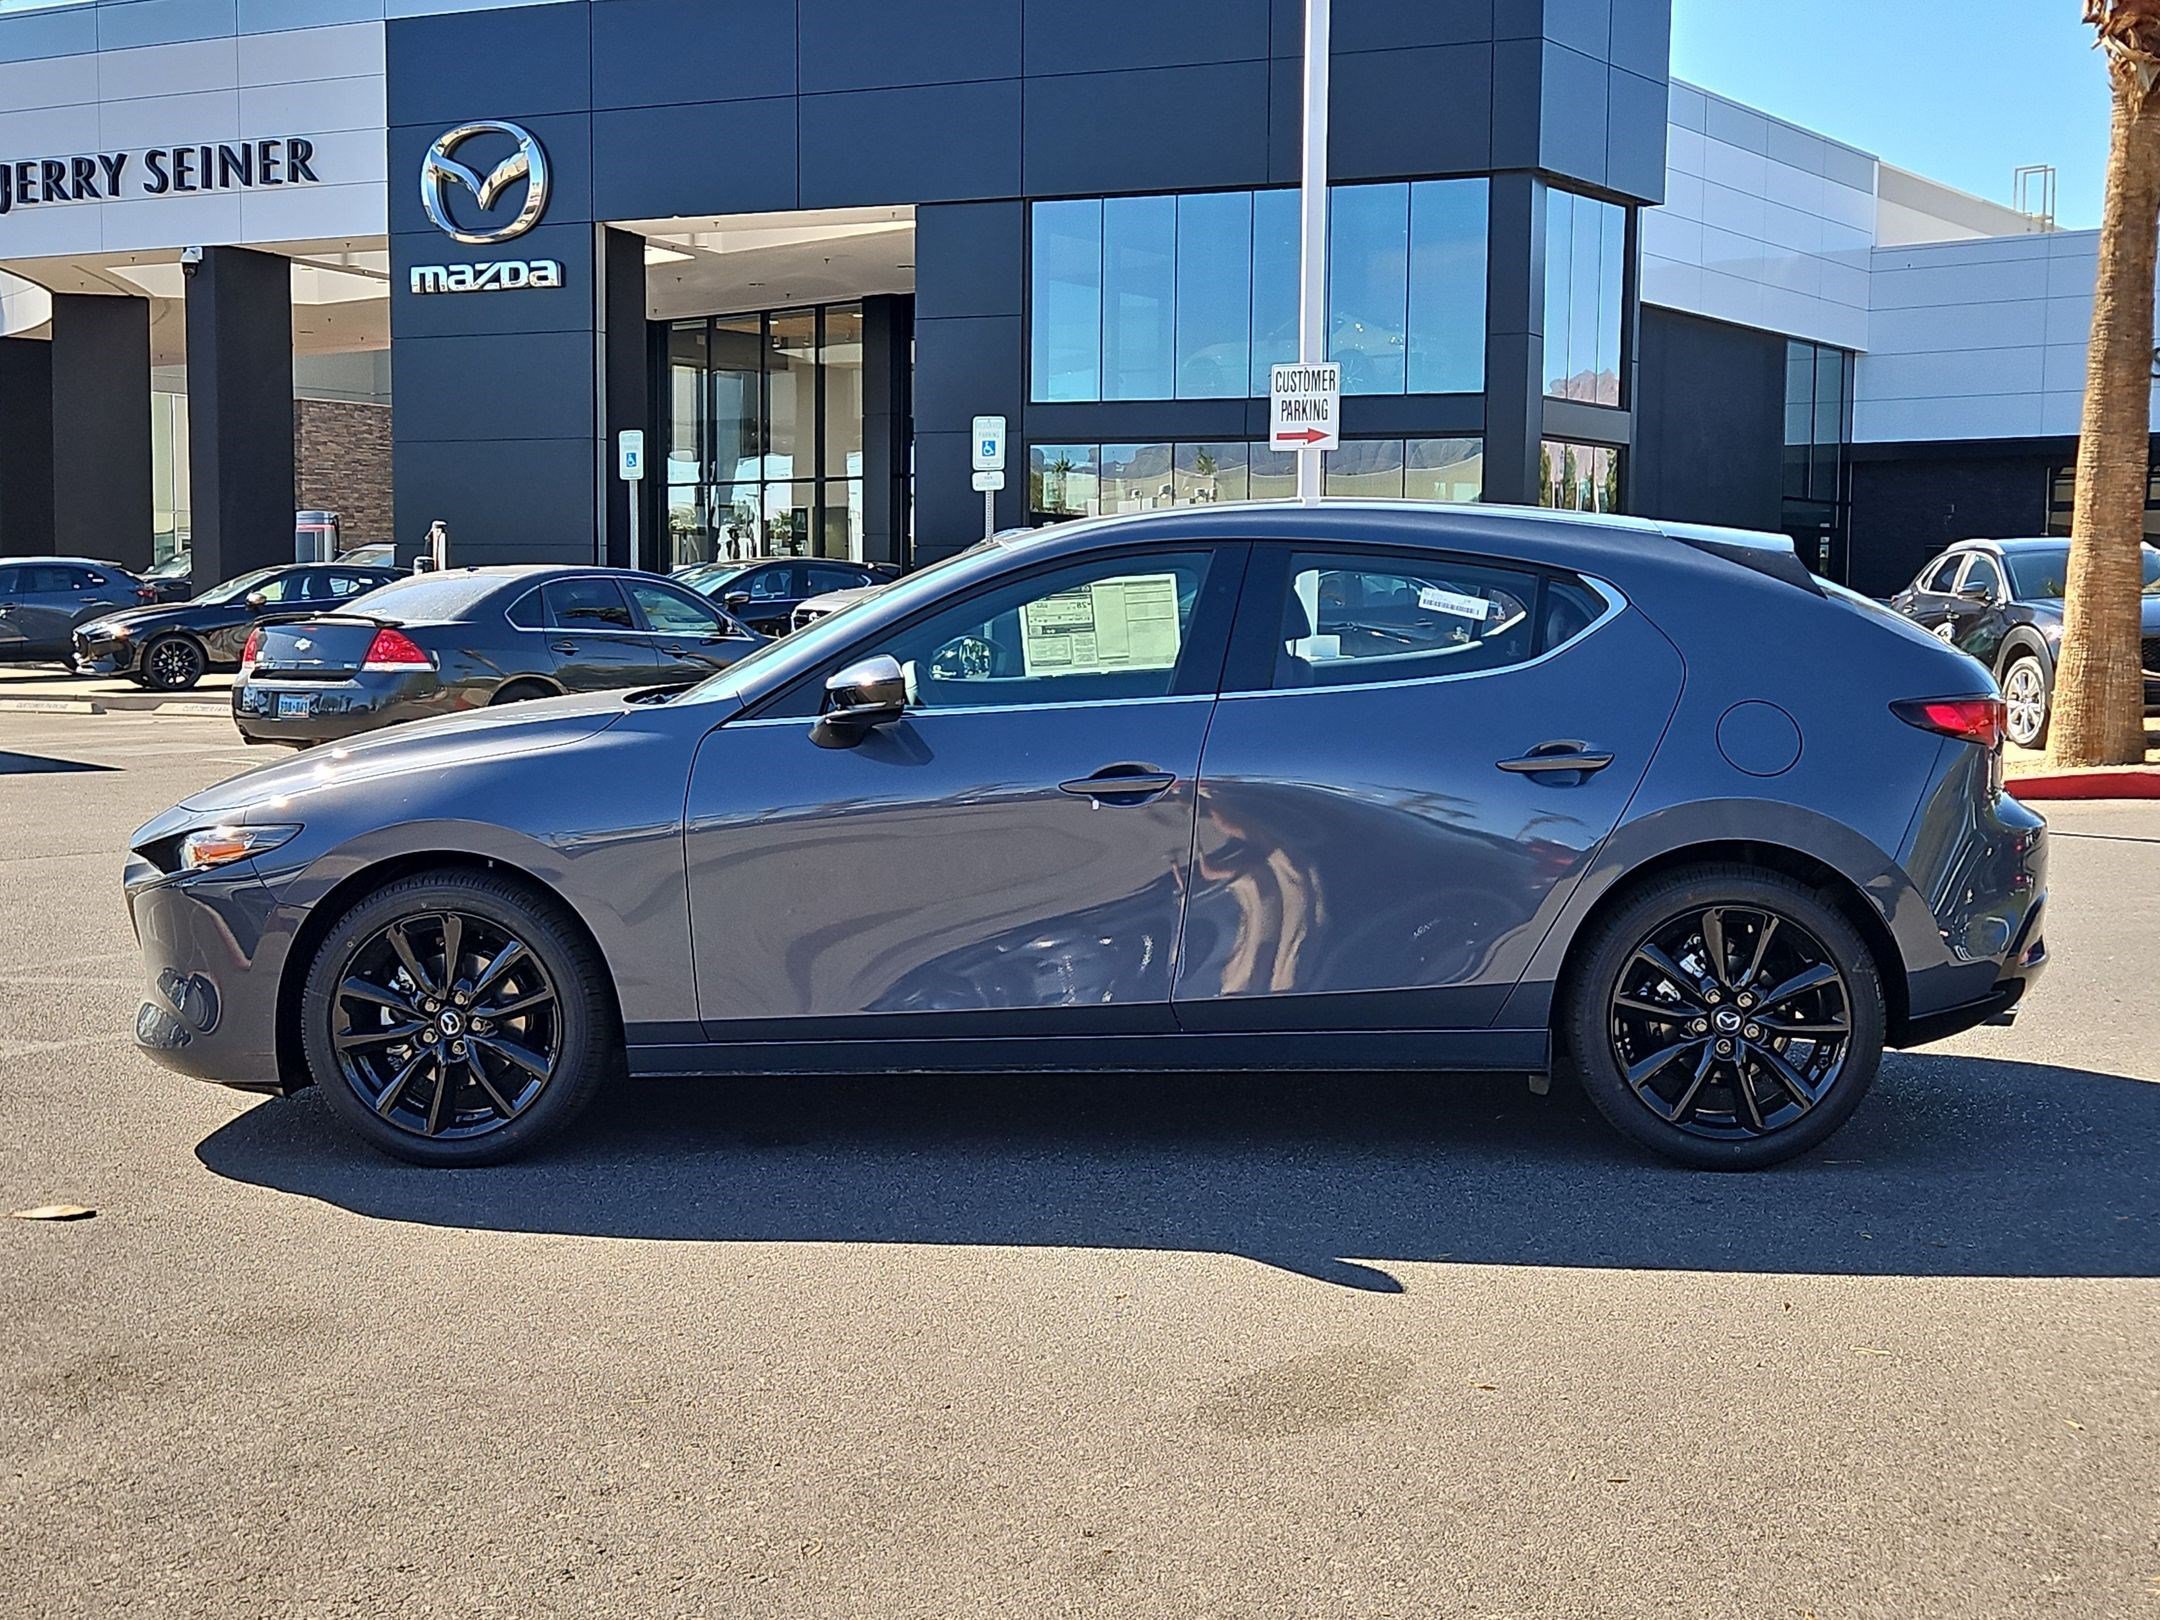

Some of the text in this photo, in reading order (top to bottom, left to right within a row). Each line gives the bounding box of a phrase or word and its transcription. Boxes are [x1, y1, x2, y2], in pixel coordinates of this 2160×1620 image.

[0, 138, 320, 214] JERRY SEINER
[410, 260, 563, 293] mazda
[1275, 369, 1336, 393] CUSTOMER
[1280, 398, 1329, 422] PARKING
